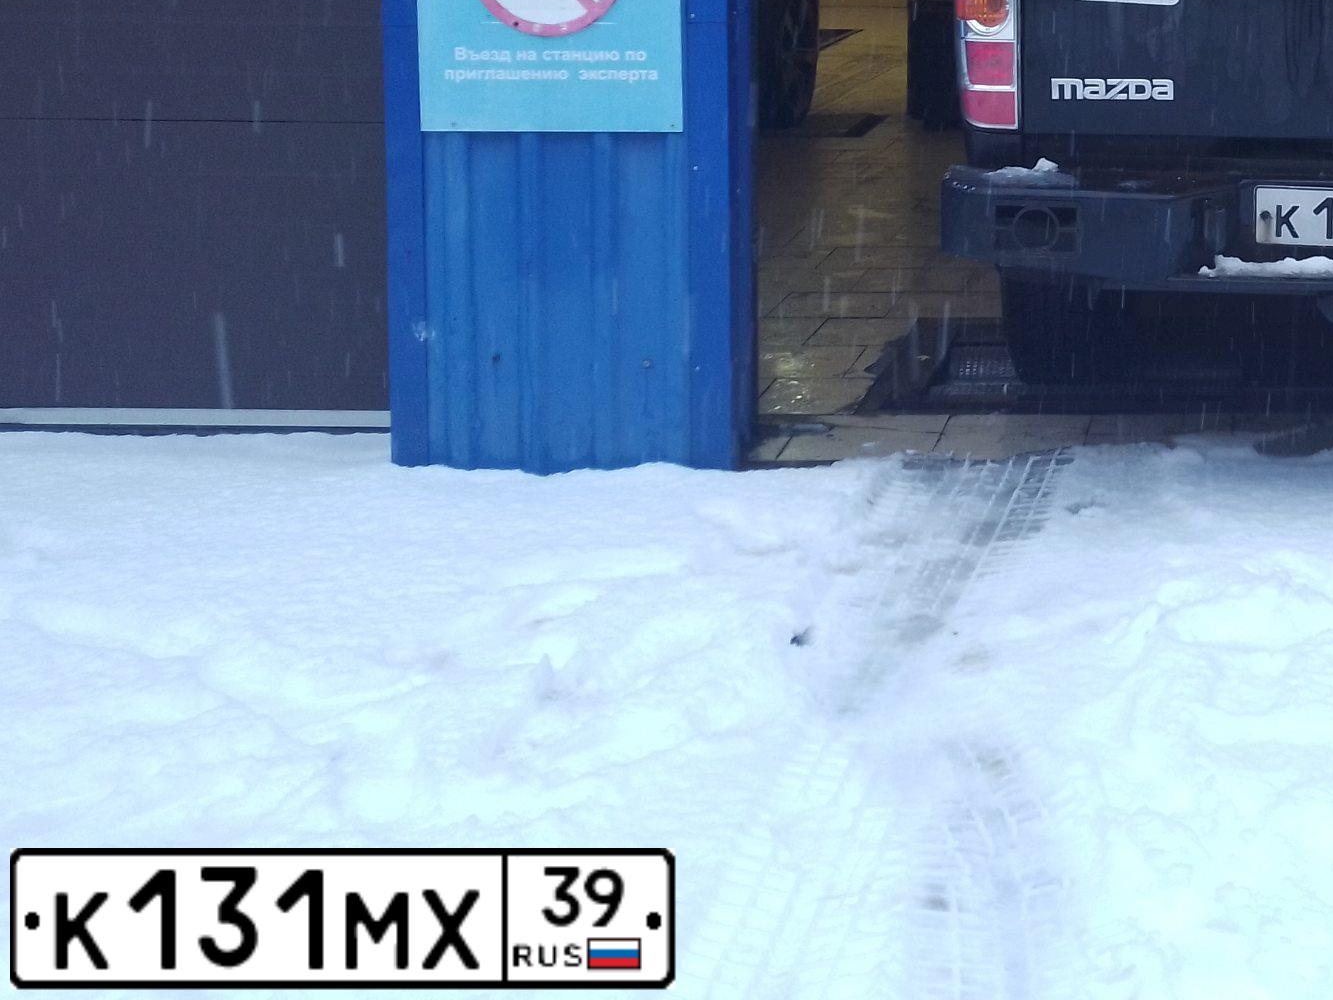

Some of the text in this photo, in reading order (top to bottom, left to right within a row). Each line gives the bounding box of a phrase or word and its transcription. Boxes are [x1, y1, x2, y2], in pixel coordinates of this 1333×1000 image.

[454, 47, 648, 63] Въезд на станцию по
[444, 68, 659, 83] приглашению эксперта
